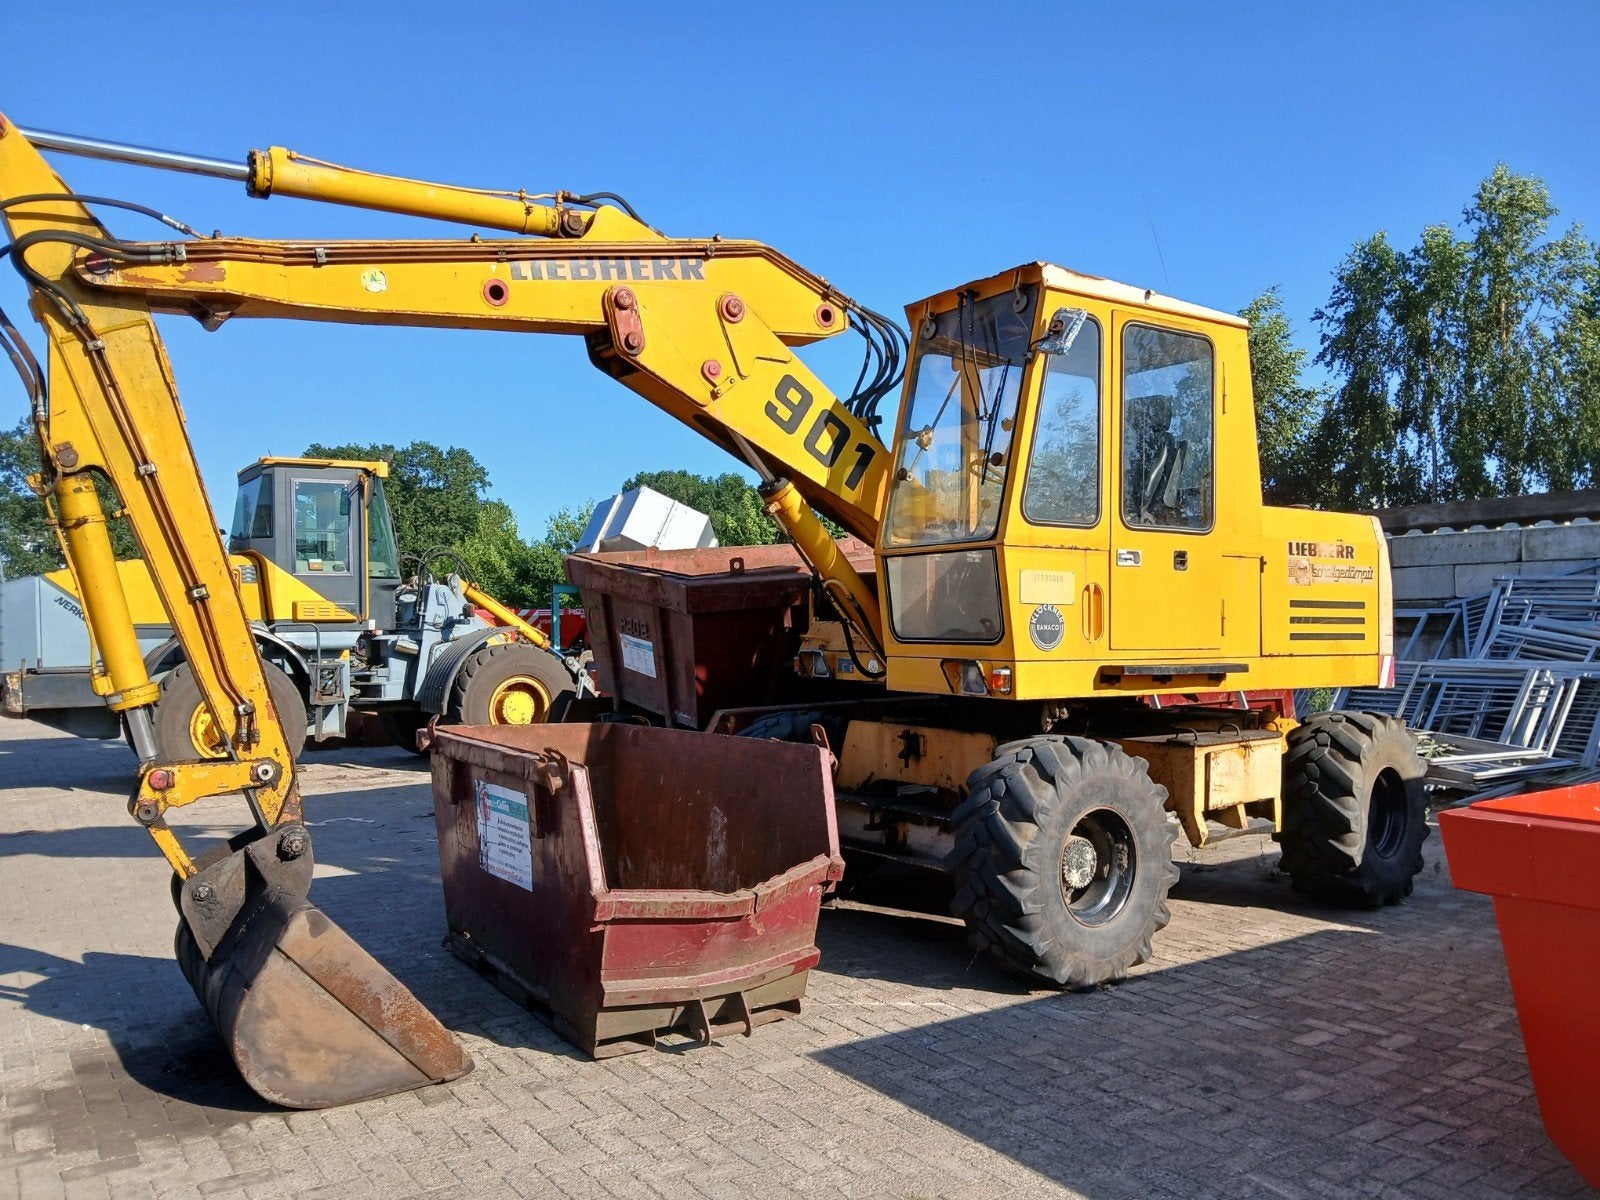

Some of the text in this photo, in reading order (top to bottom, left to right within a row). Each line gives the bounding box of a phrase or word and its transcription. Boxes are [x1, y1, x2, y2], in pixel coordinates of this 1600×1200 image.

[510, 257, 705, 281] LIEBHERR
[764, 373, 876, 492] 901
[1288, 541, 1355, 559] LIEBRR
